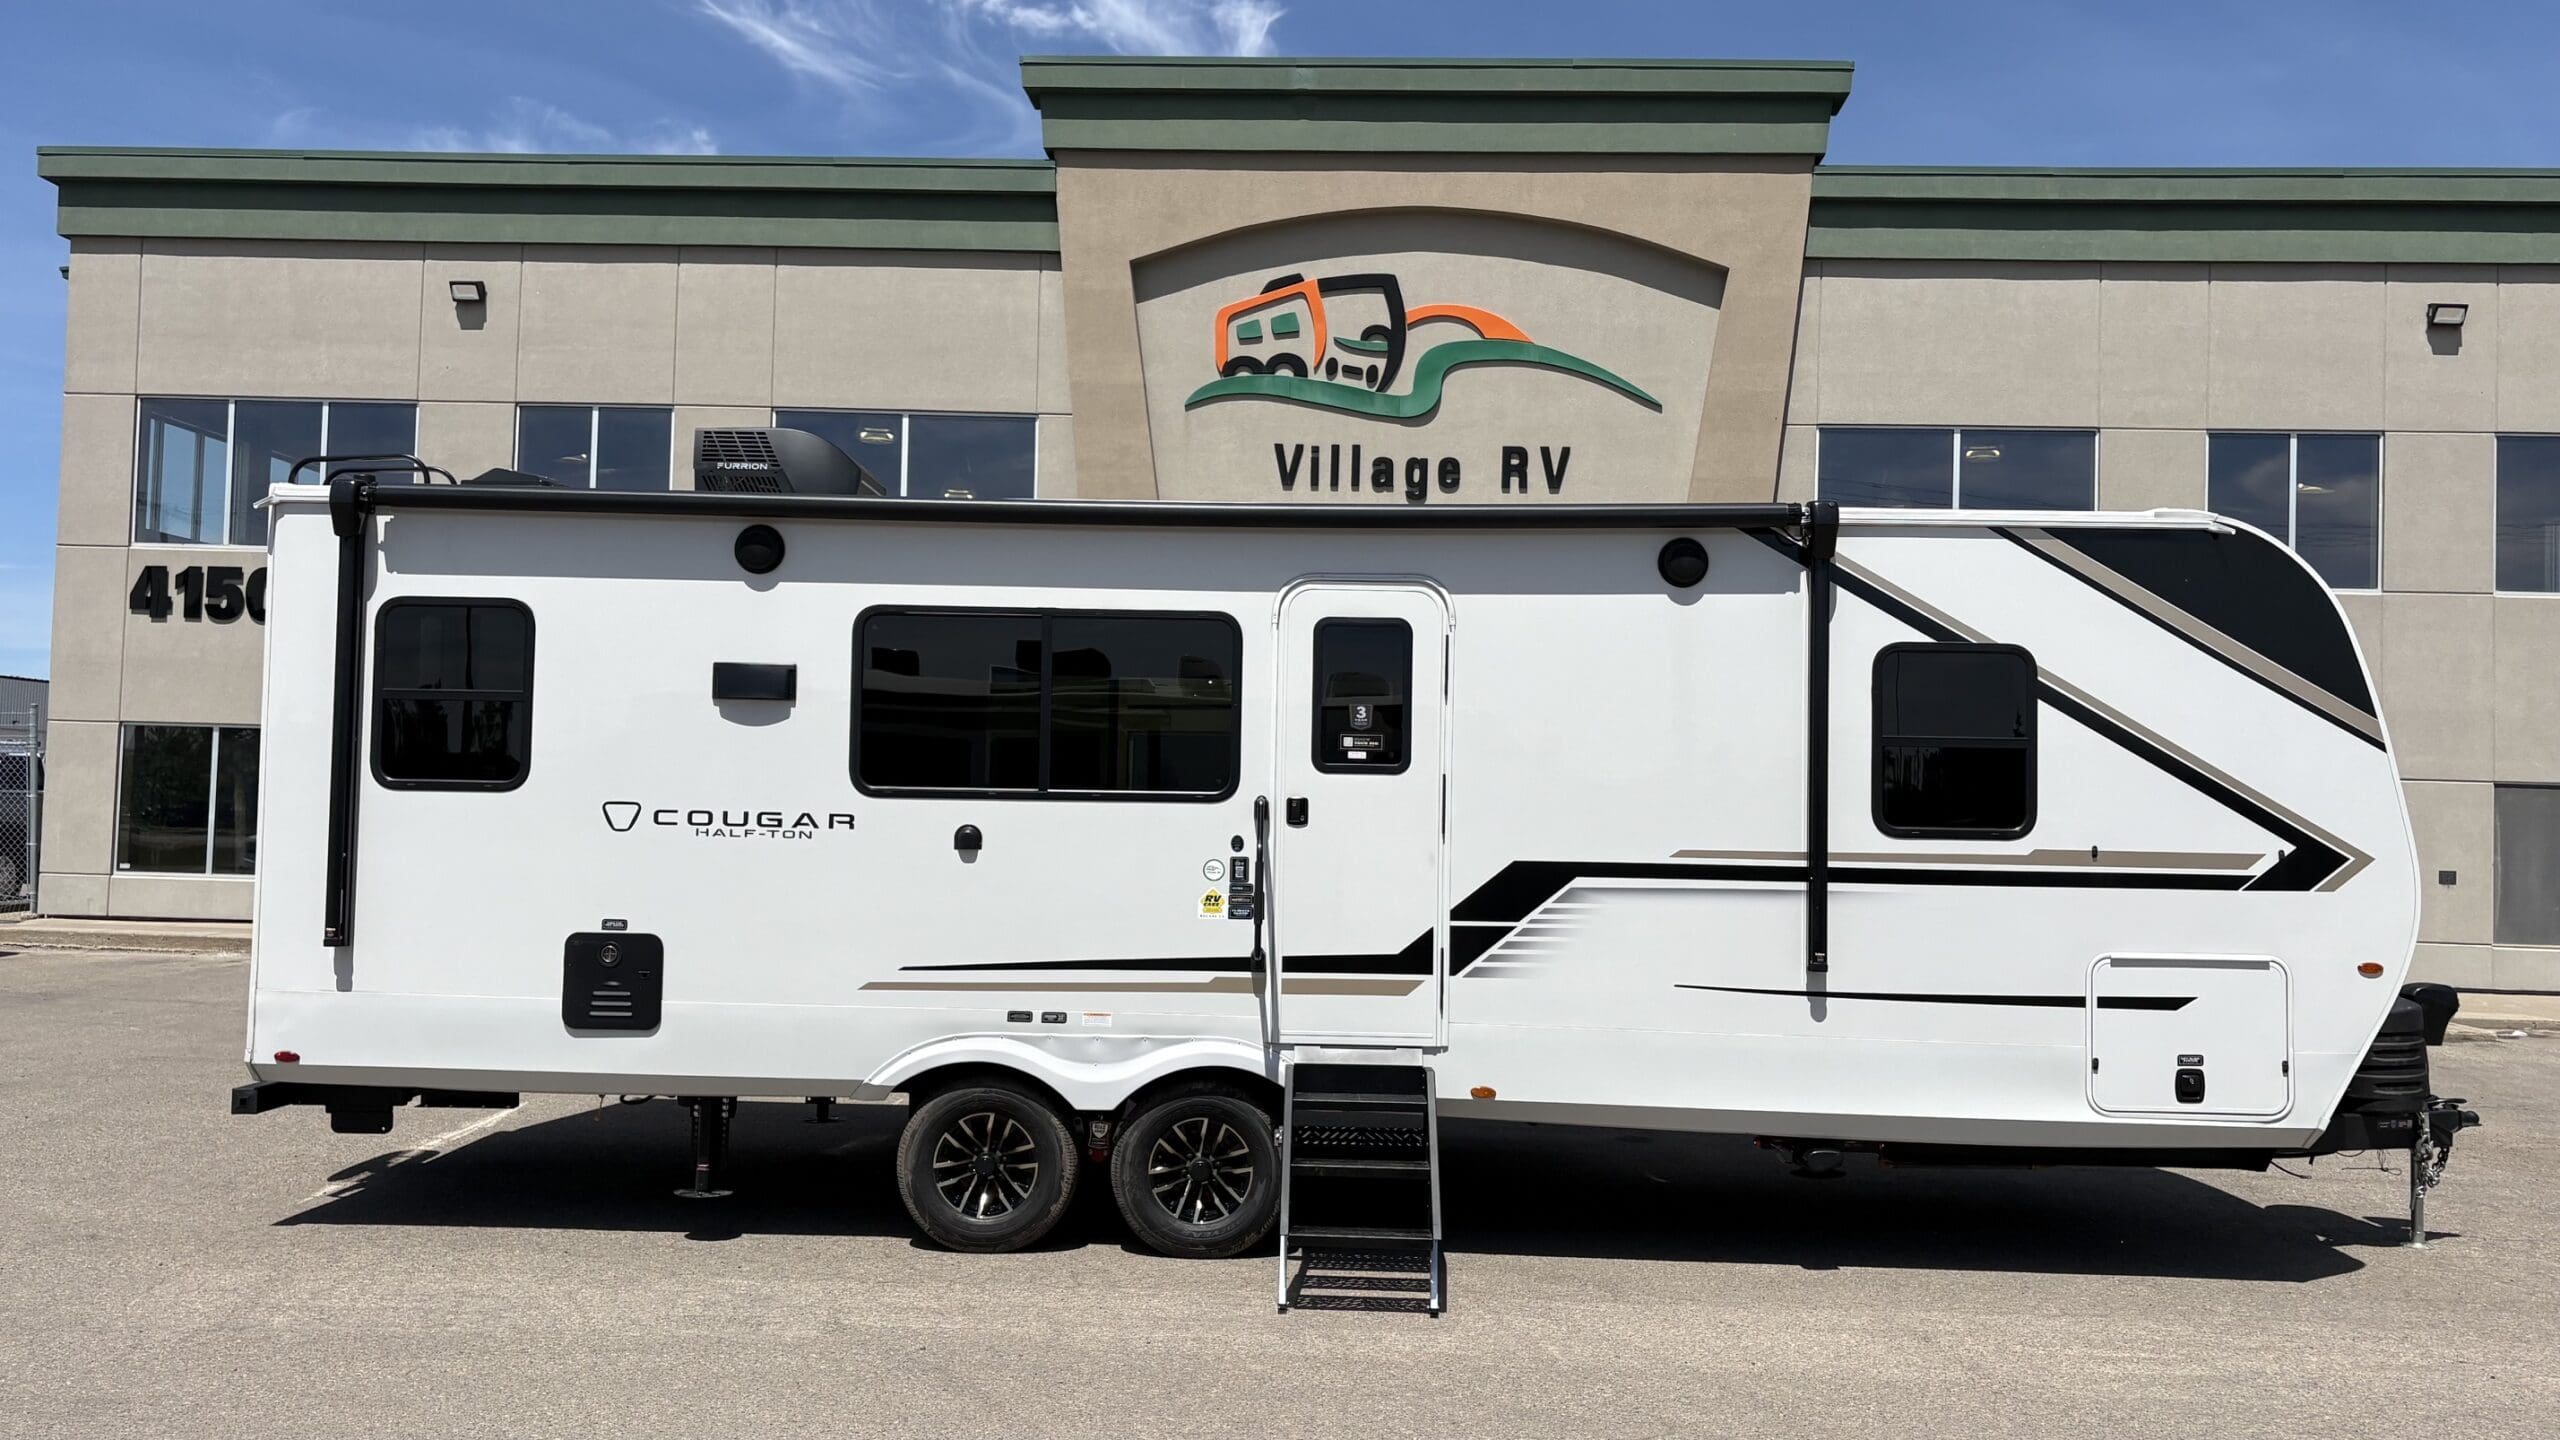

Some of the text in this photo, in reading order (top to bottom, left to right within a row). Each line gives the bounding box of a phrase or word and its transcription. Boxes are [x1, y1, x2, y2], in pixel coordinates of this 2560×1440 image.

[717, 462, 769, 471] FURRION
[1274, 443, 1571, 502] Village RV
[1355, 706, 1367, 719] 3
[652, 809, 856, 830] COUGAR
[695, 828, 813, 840] HALF-TON
[1204, 894, 1222, 903] RV
